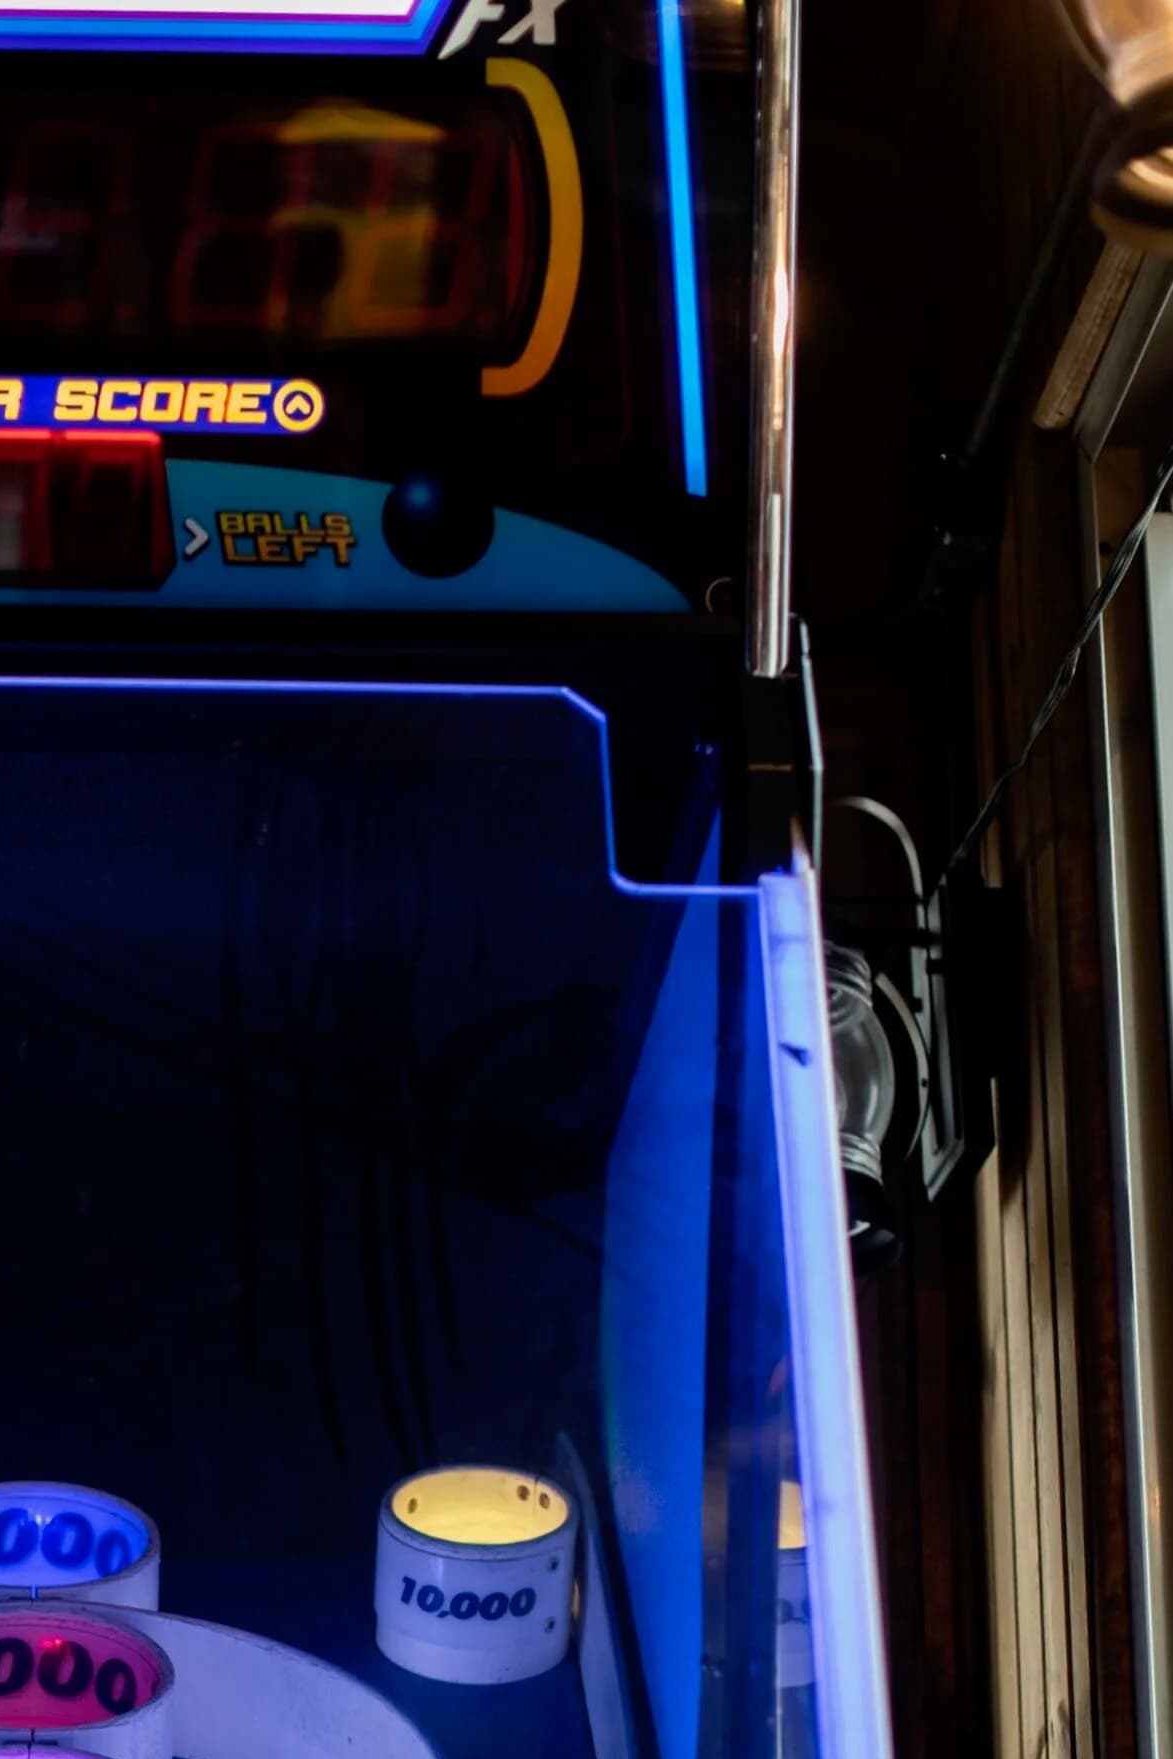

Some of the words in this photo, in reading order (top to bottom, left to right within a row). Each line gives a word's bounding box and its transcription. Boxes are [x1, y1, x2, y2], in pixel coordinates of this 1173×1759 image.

[54, 380, 272, 424] SCORE
[218, 511, 352, 536] BALLS
[222, 534, 356, 565] LEFT
[399, 1576, 537, 1622] 10,000
